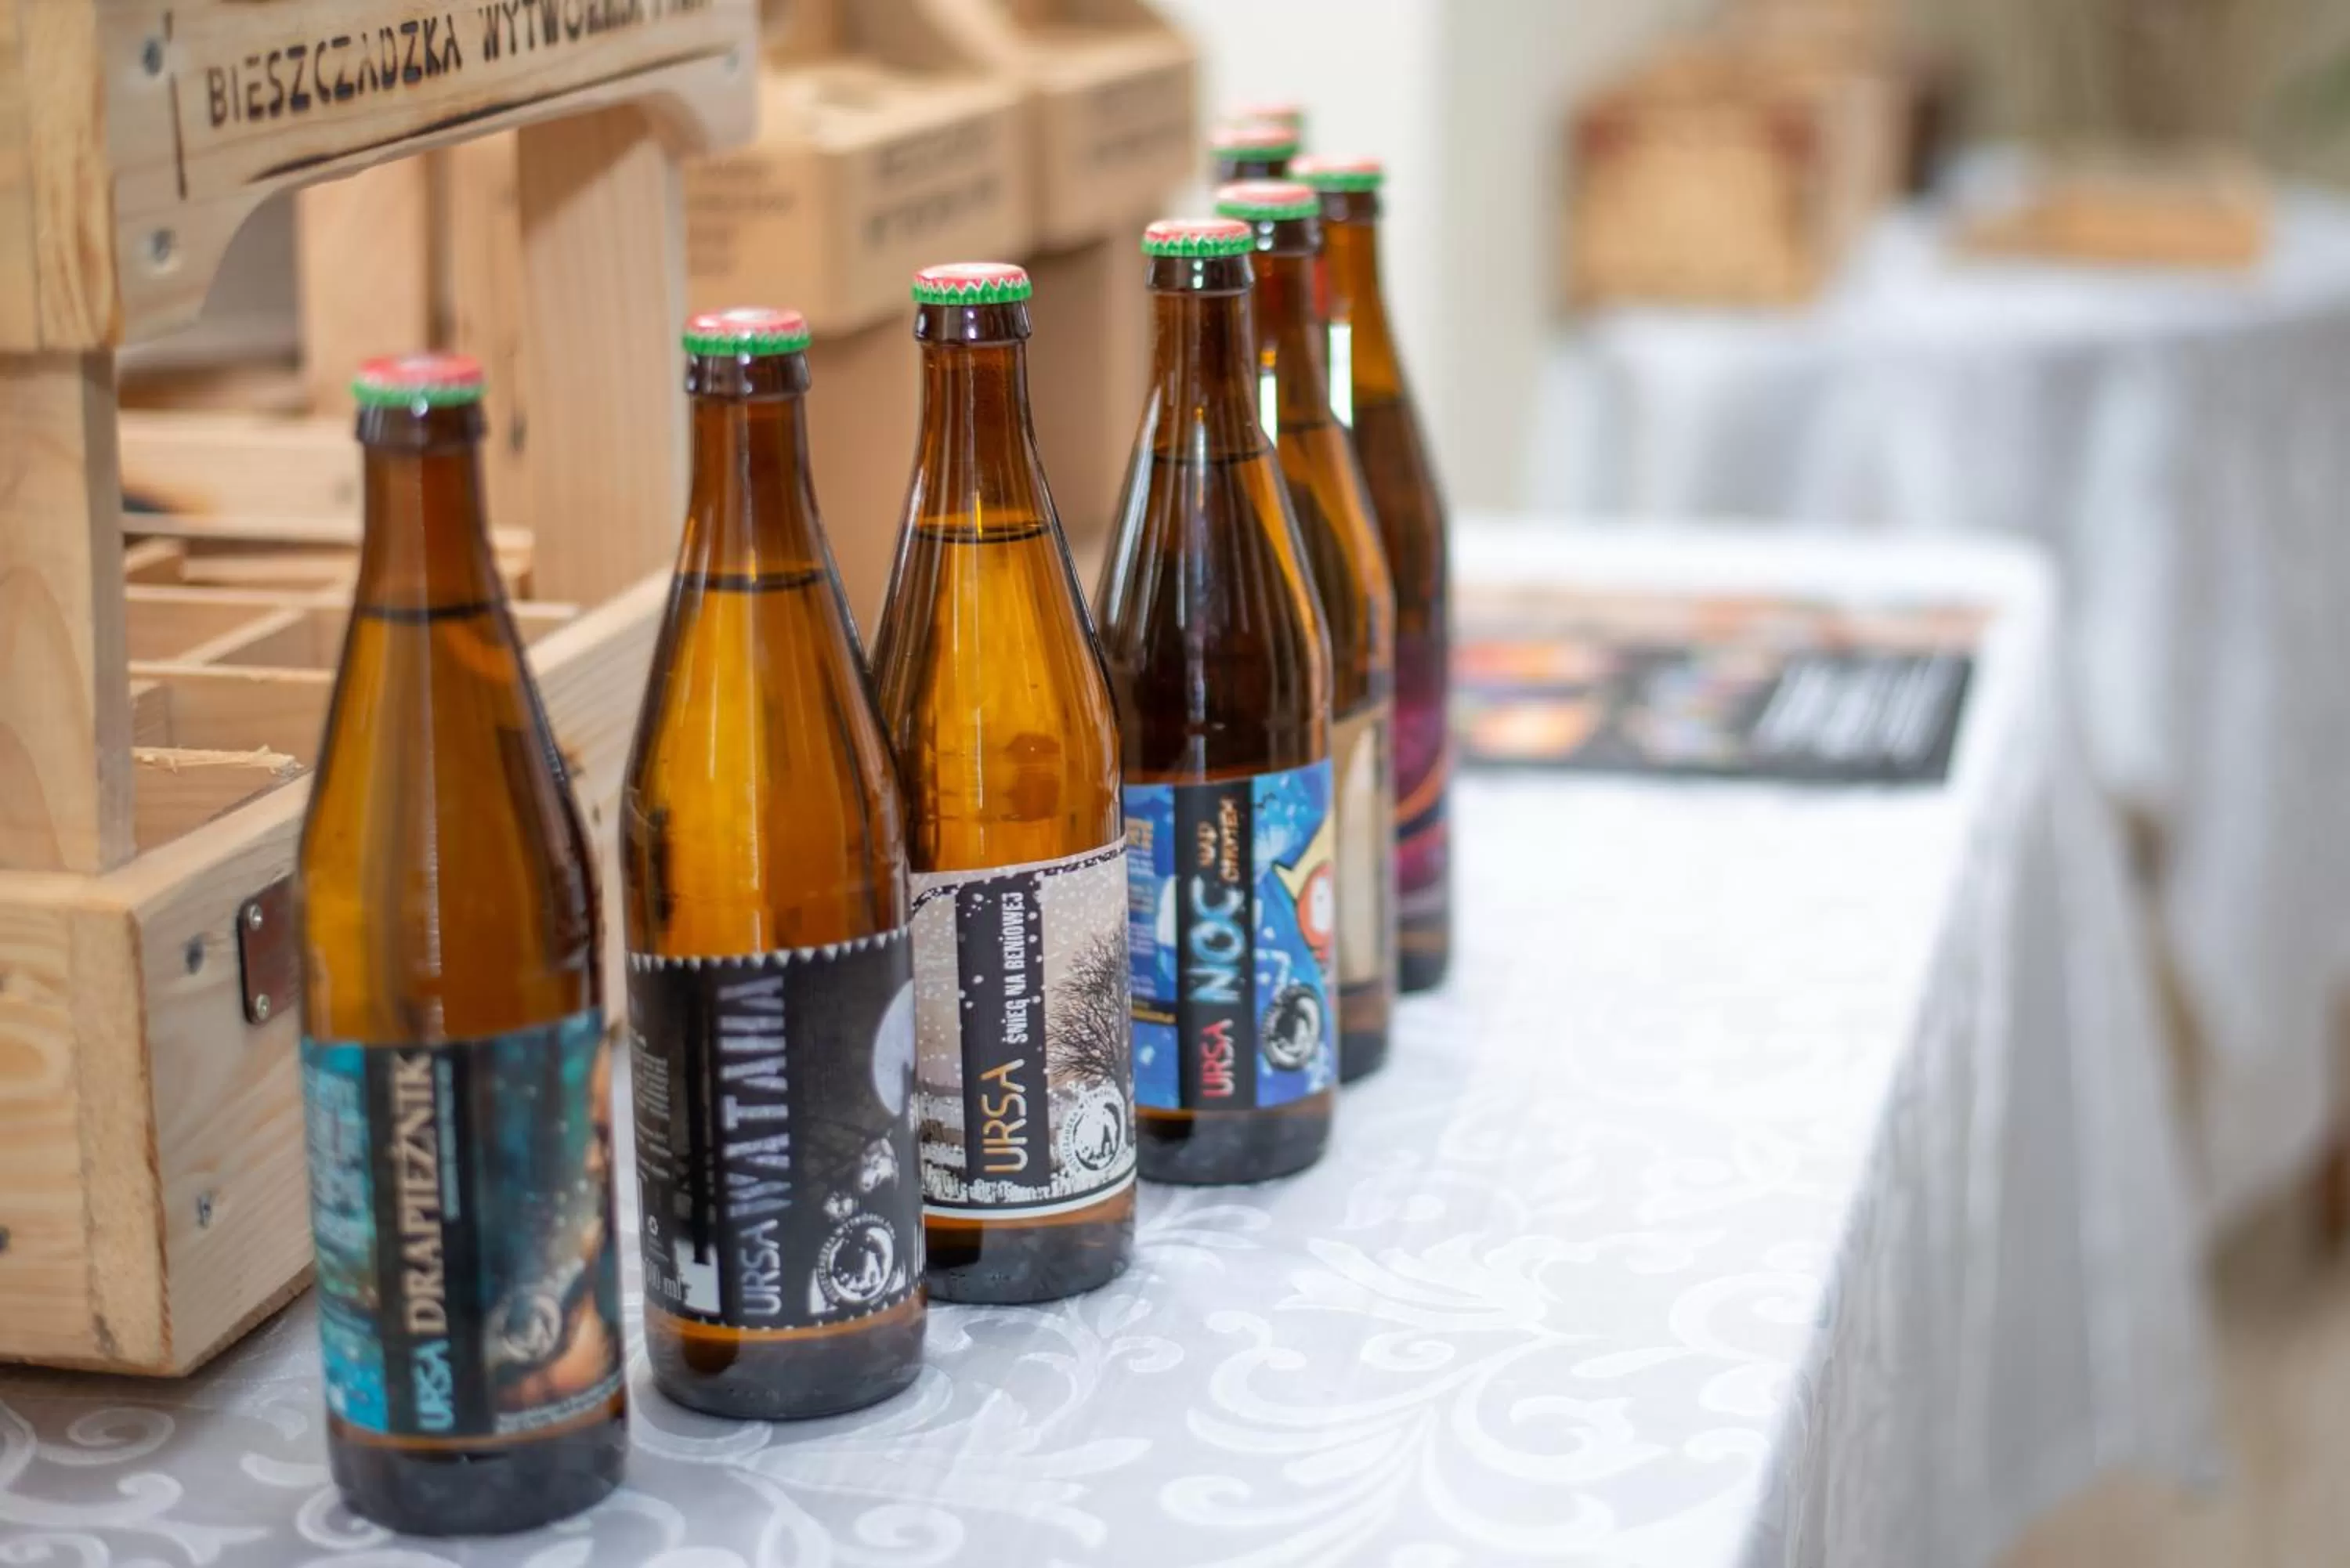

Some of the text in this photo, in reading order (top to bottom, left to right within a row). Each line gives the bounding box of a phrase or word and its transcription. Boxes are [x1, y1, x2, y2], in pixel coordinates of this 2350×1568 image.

[207, 12, 463, 128] BIESZCZADZKA
[1003, 974, 1027, 997] NA
[1184, 873, 1247, 1099] URSA NOC
[717, 974, 792, 1317] URSA WATAHA
[979, 1057, 1029, 1172] URSA
[411, 1338, 454, 1431] URSA
